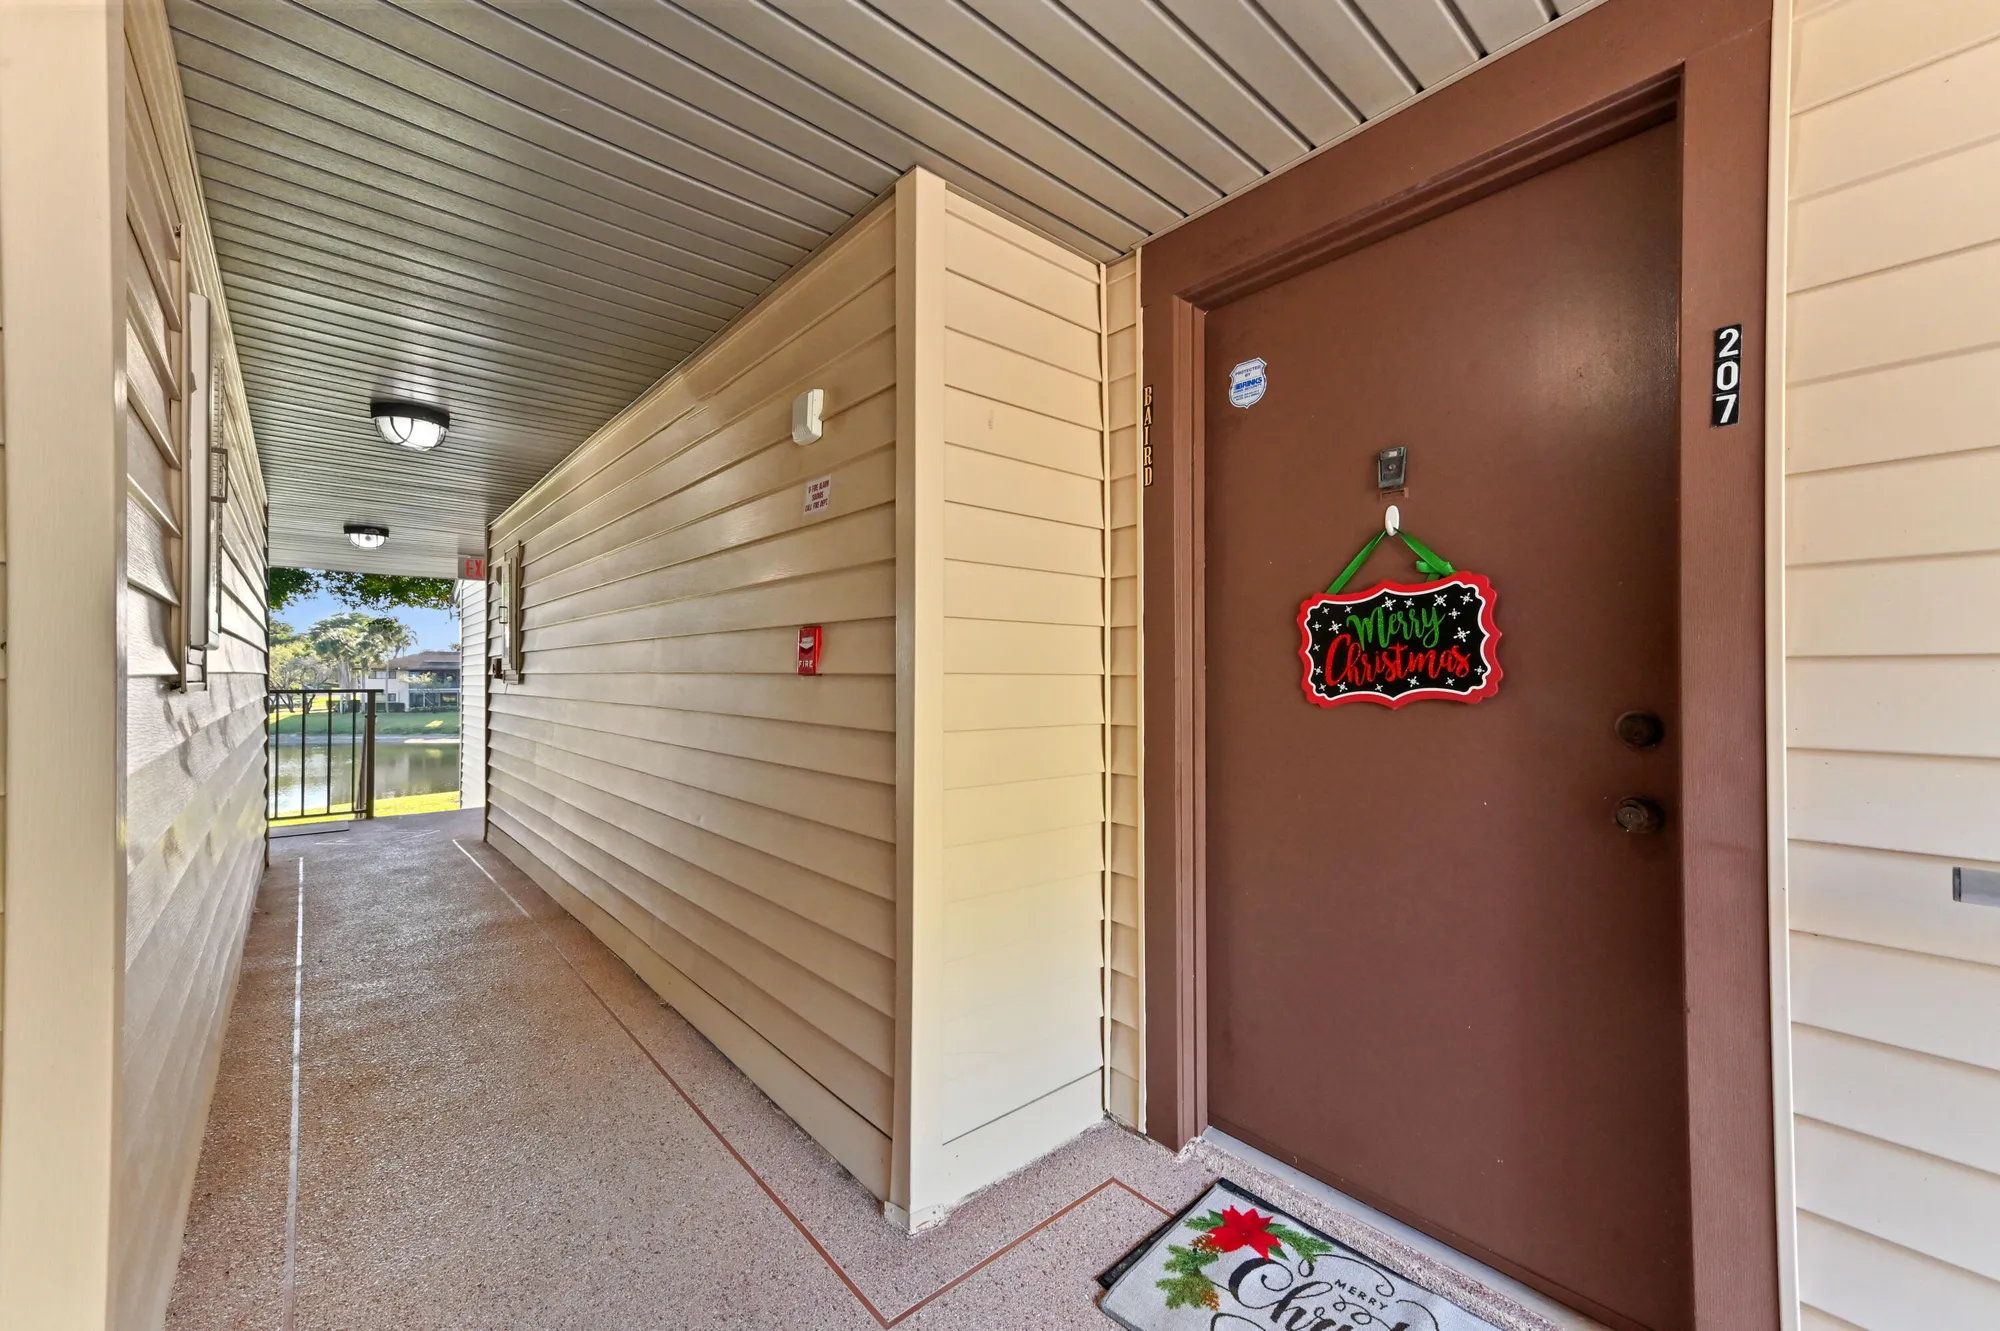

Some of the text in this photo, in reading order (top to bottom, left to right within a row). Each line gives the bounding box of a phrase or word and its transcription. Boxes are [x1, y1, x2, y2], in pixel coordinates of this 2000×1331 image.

[1715, 328, 1739, 424] 207
[1143, 386, 1152, 487] BAIRD
[1346, 606, 1446, 651] Merry
[799, 660, 813, 668] FIRE
[1325, 634, 1471, 686] Christmas
[1335, 1279, 1388, 1310] MERRY
